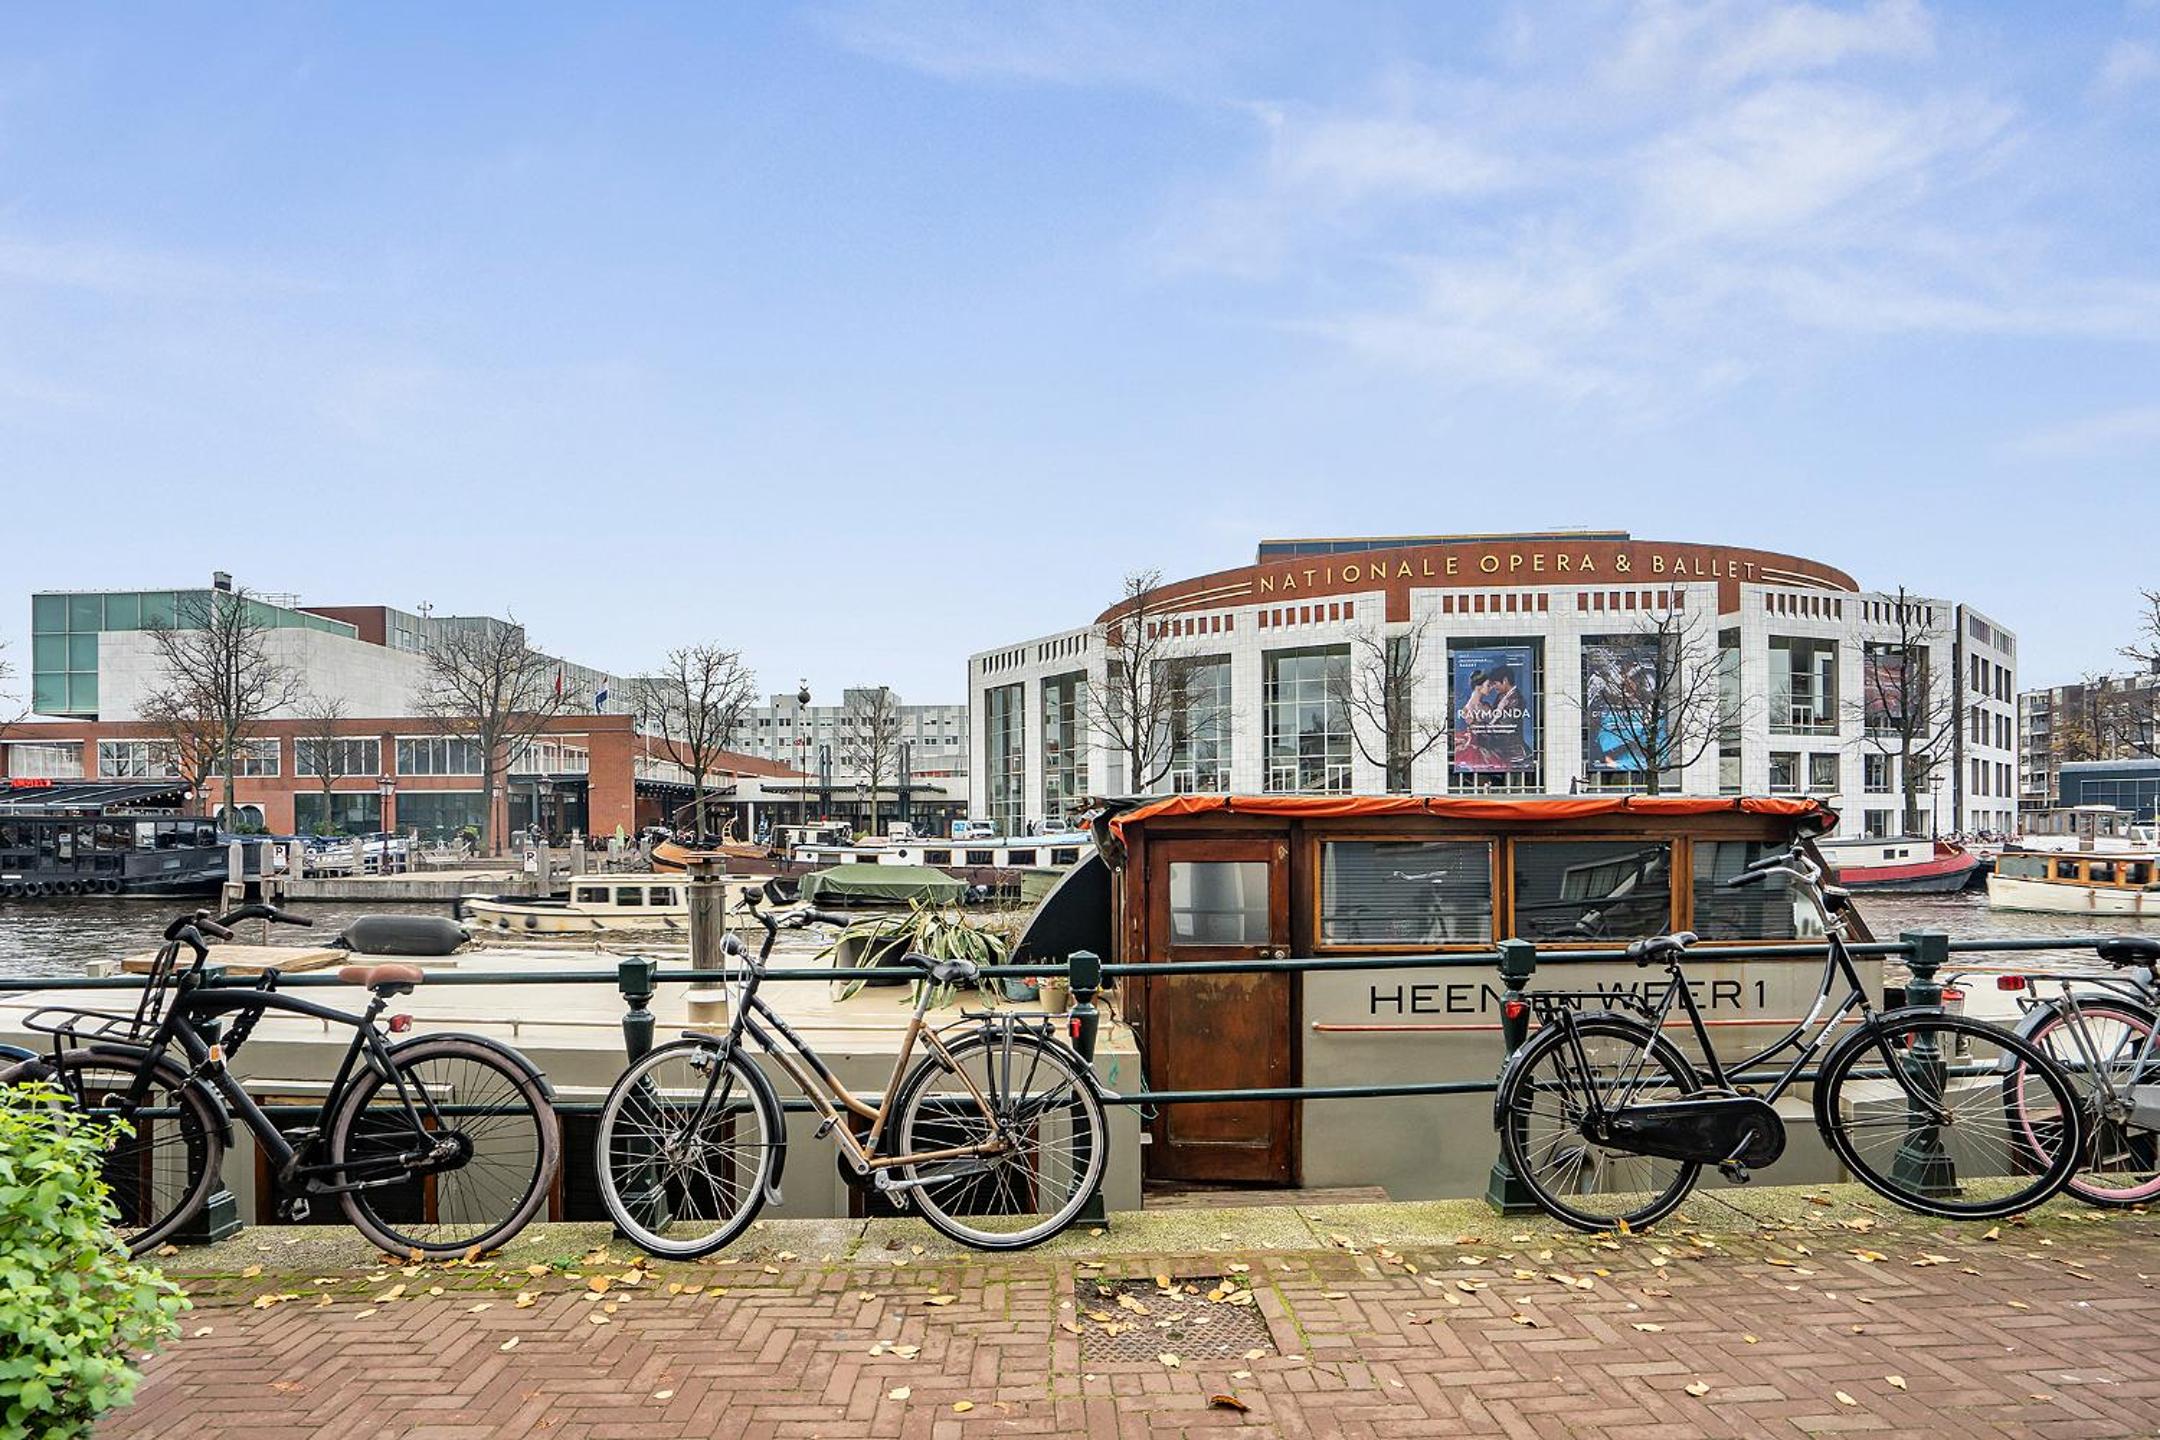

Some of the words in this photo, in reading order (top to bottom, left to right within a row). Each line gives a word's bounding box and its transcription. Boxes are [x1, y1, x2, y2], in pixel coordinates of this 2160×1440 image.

[1260, 556, 1459, 593] NATIONALE
[1479, 553, 1596, 573] OPERA
[1615, 554, 1632, 573] &
[1652, 555, 1755, 579] BALLET
[1457, 708, 1531, 719] RAYMONDA
[275, 846, 283, 856] P
[526, 851, 535, 861] P
[1370, 983, 1502, 1014] HEEN
[1596, 980, 1742, 1011] WEER
[1754, 979, 1766, 1009] 1
